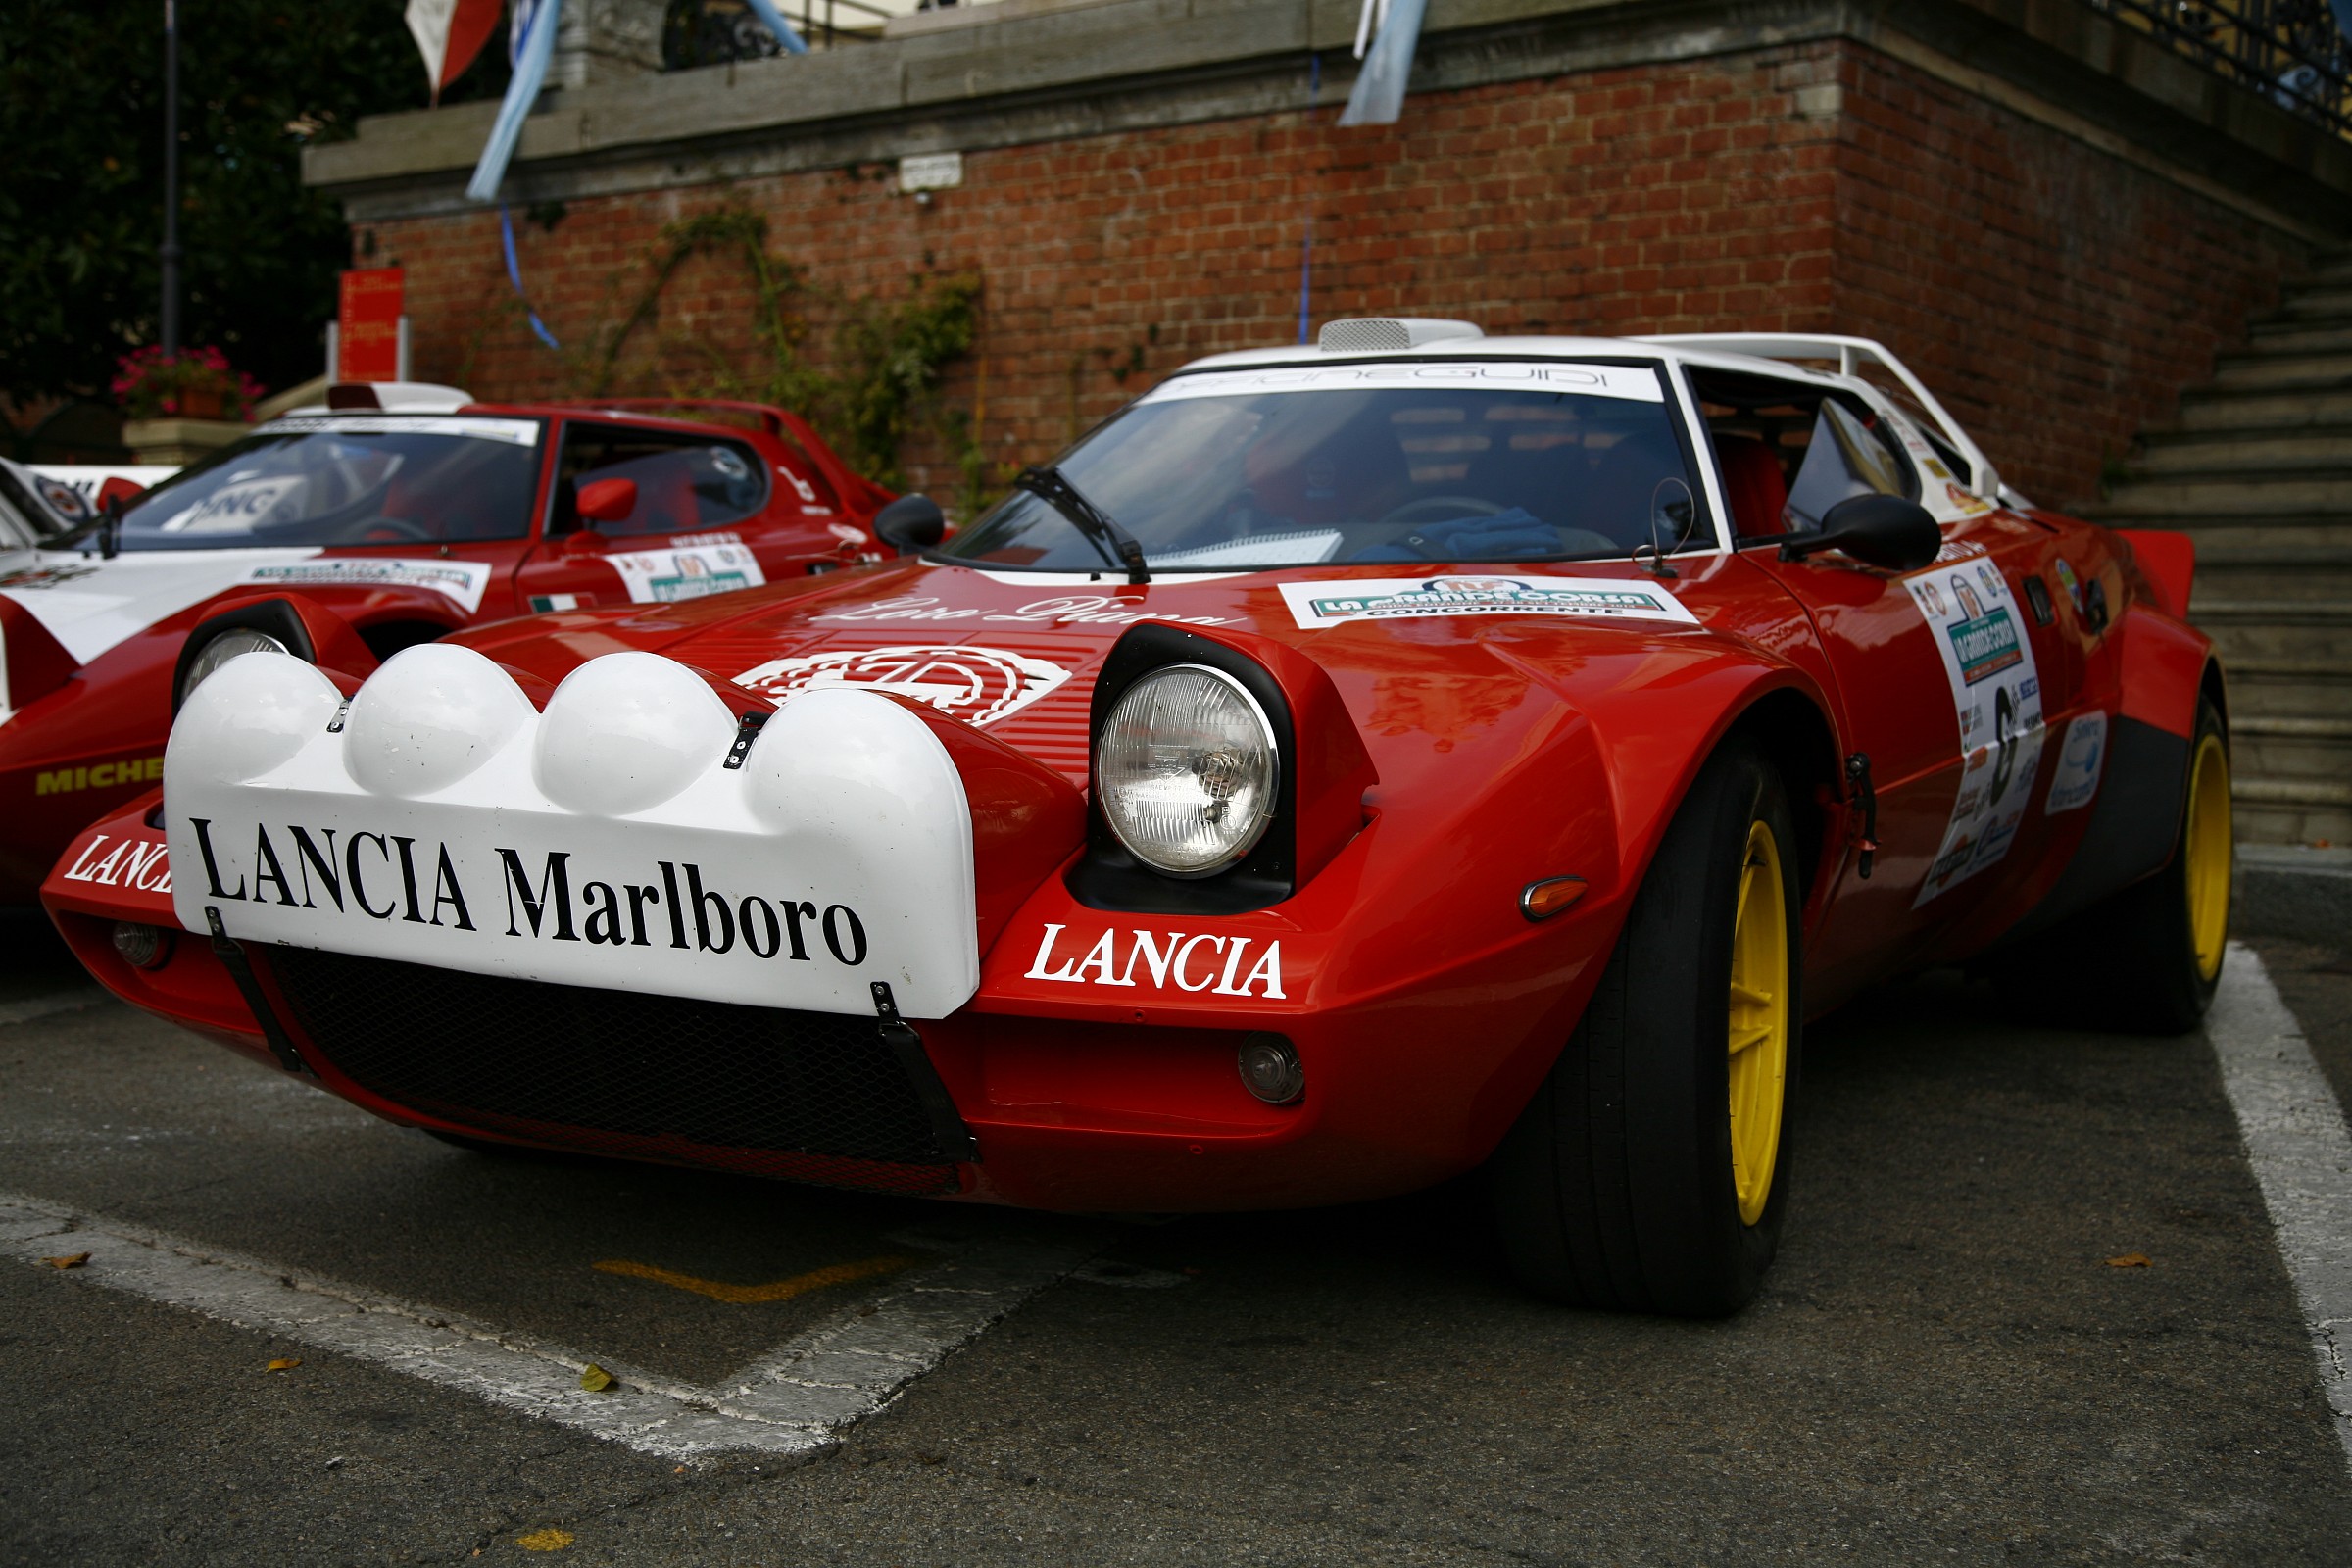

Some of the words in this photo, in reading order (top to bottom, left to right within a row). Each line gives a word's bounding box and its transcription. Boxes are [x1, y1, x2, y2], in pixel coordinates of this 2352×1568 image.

[1367, 592, 1514, 607] GRANDE
[1518, 592, 1646, 605] CORSA
[1367, 606, 1624, 616] CONCORRENTE
[188, 817, 477, 932] LANCIA
[494, 848, 868, 966] Marlboro
[1023, 923, 1287, 999] LANCIA
